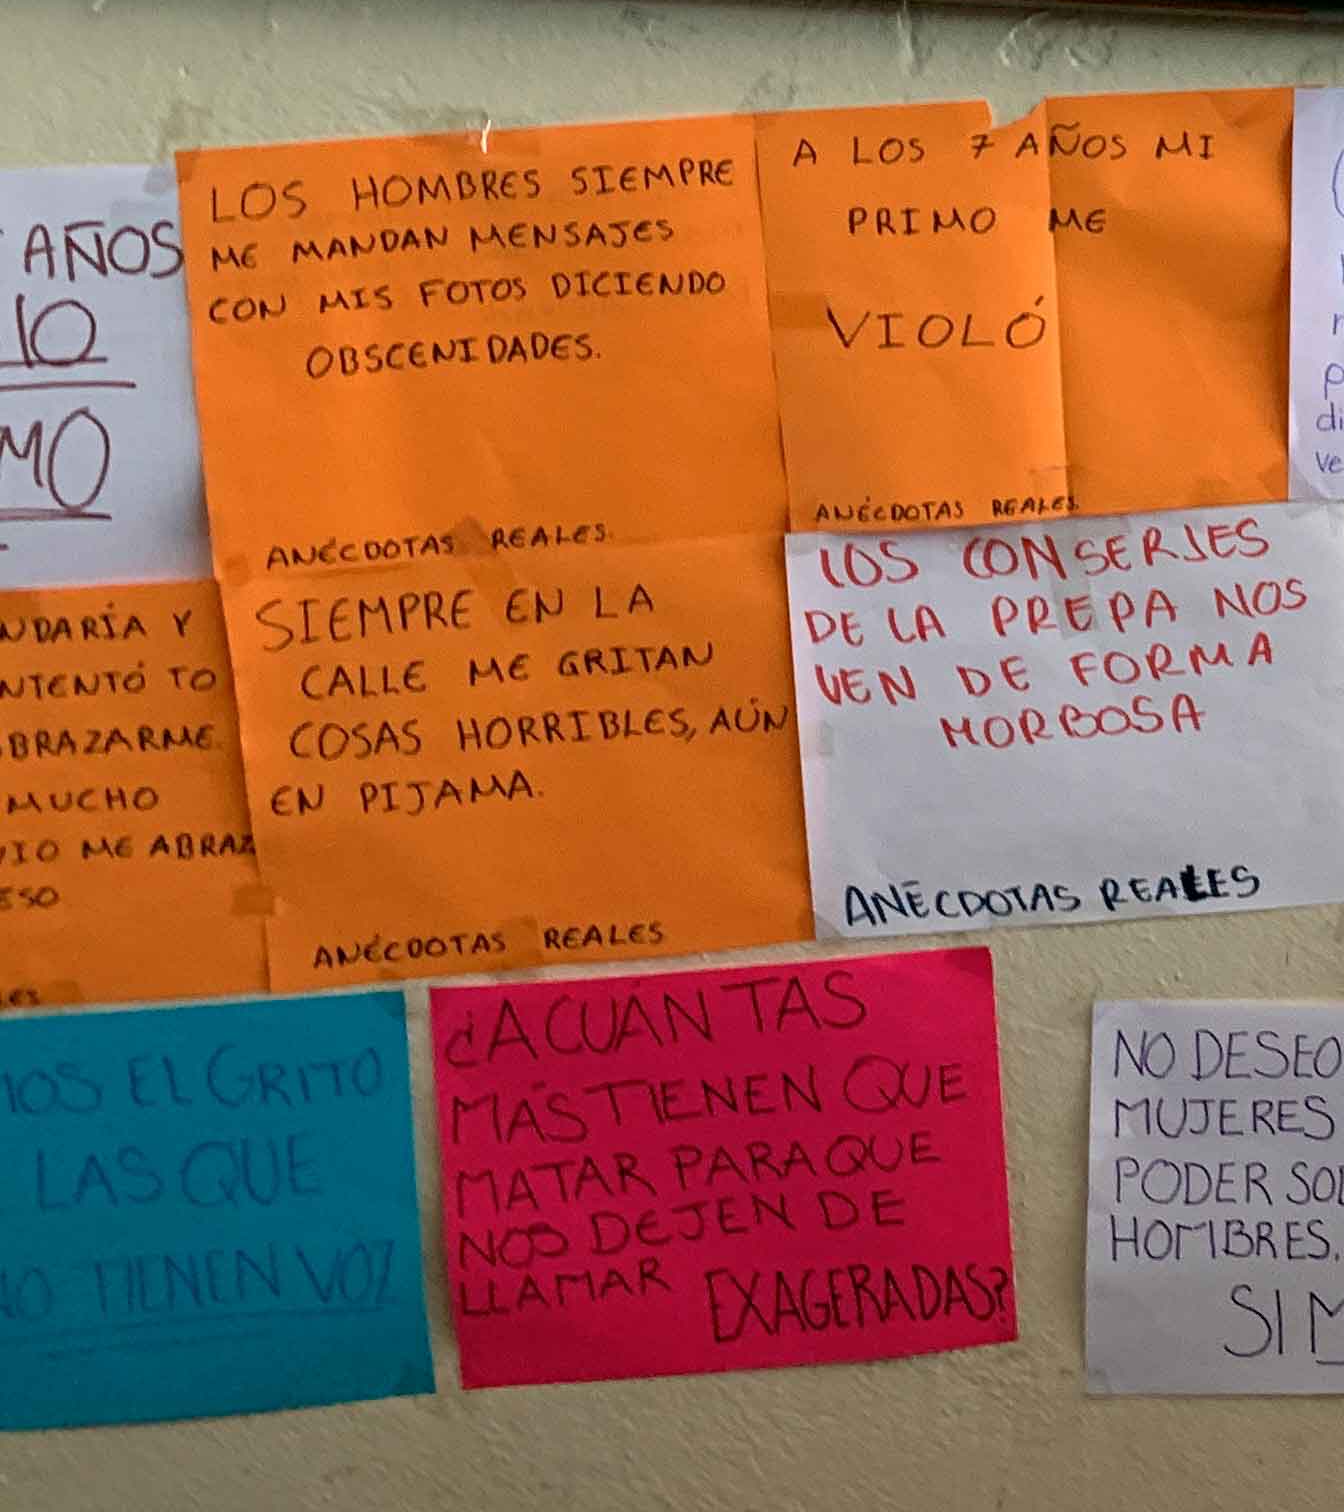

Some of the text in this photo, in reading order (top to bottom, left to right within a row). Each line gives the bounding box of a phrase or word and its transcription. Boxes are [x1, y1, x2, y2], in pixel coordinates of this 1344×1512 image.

[209, 156, 735, 225] LOS HOMBRES SIEMPRE
[847, 203, 1107, 239] PRIMO ME
[825, 294, 1048, 353] VIOLÓ
[305, 331, 603, 379] OBSCENIDADES.
[1112, 1029, 1175, 1079] NO
[1194, 1031, 1344, 1079] DESEO
[1112, 1096, 1335, 1140] MUJERES
